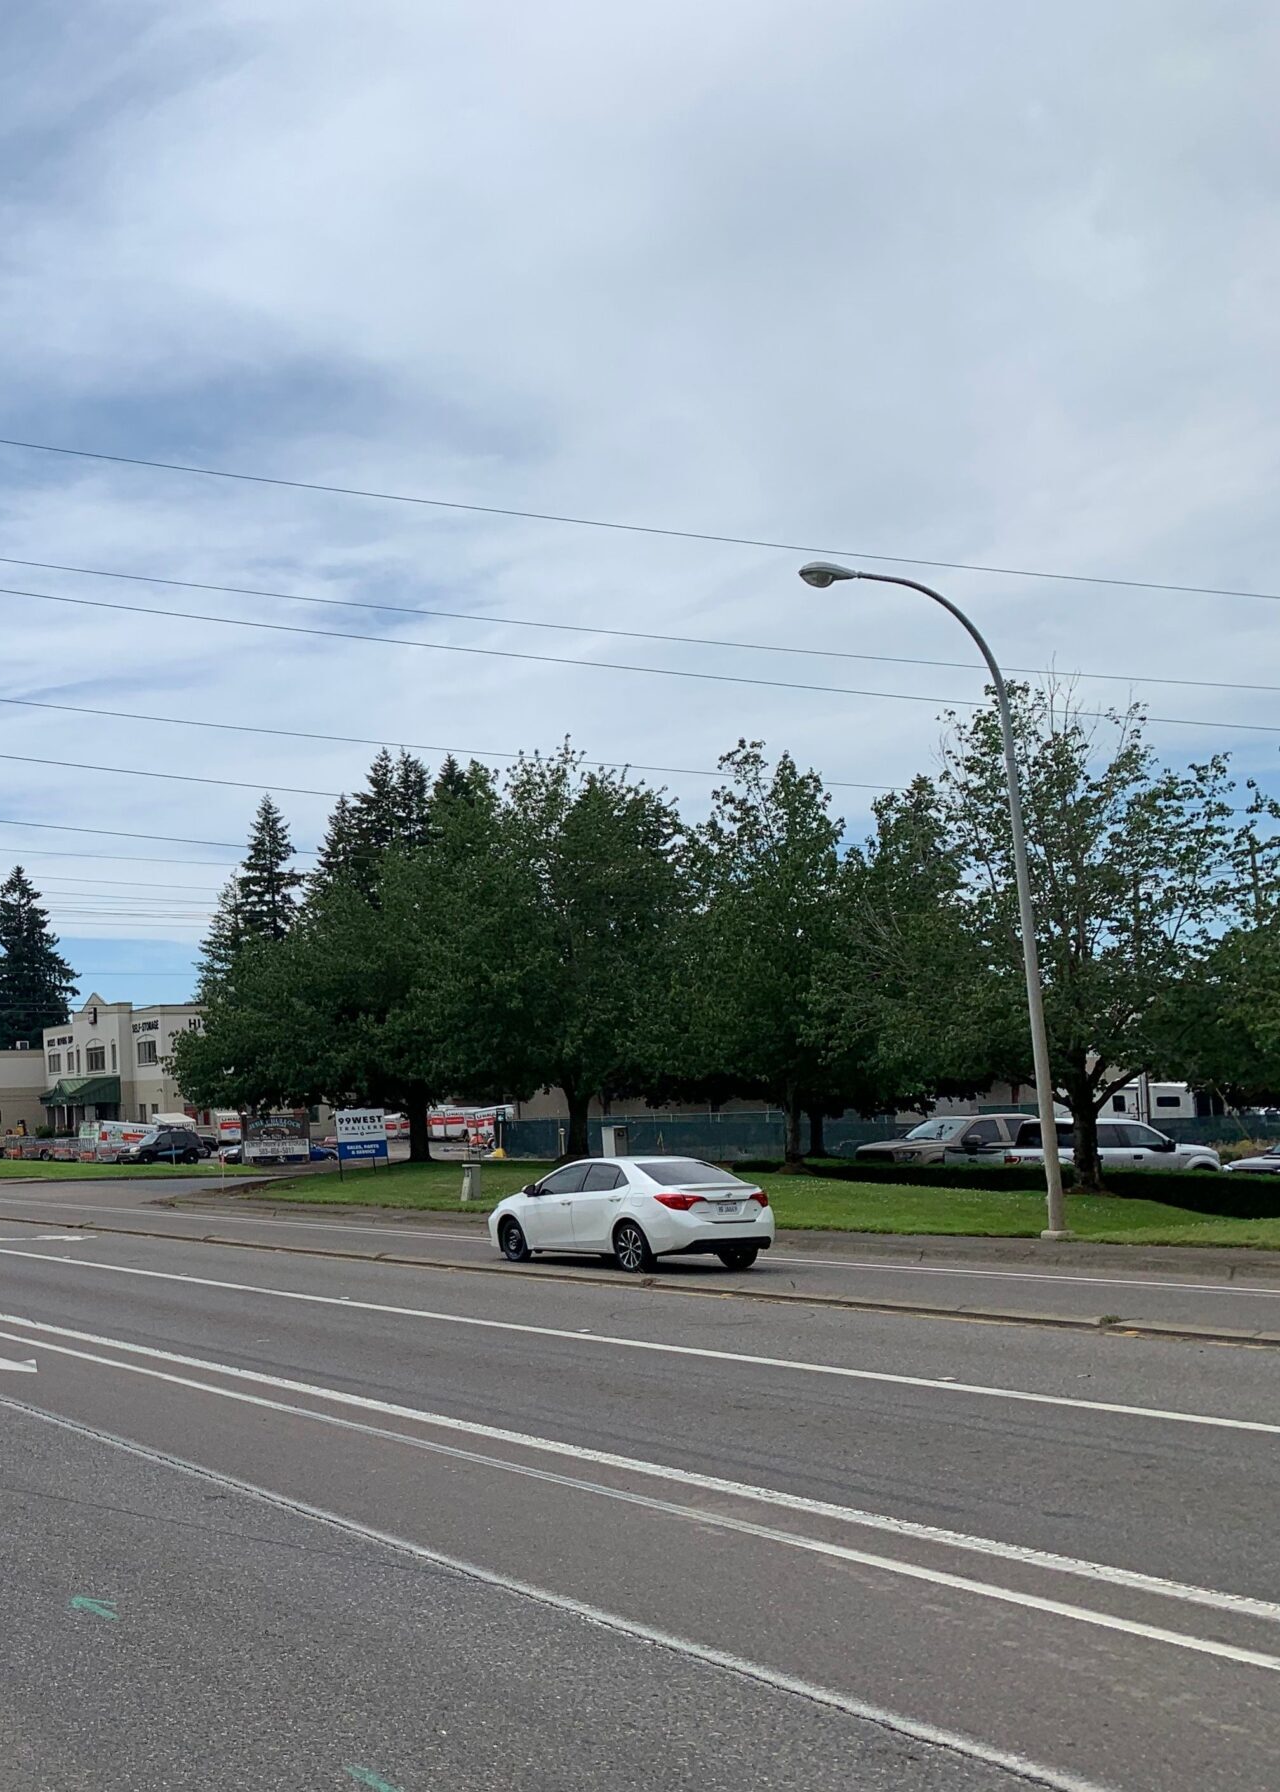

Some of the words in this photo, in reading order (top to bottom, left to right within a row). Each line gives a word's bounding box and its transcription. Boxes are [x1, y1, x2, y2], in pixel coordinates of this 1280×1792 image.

[131, 1020, 160, 1033] SELF-STORAGE
[188, 1018, 201, 1029] HI
[337, 1115, 383, 1125] 99WEST
